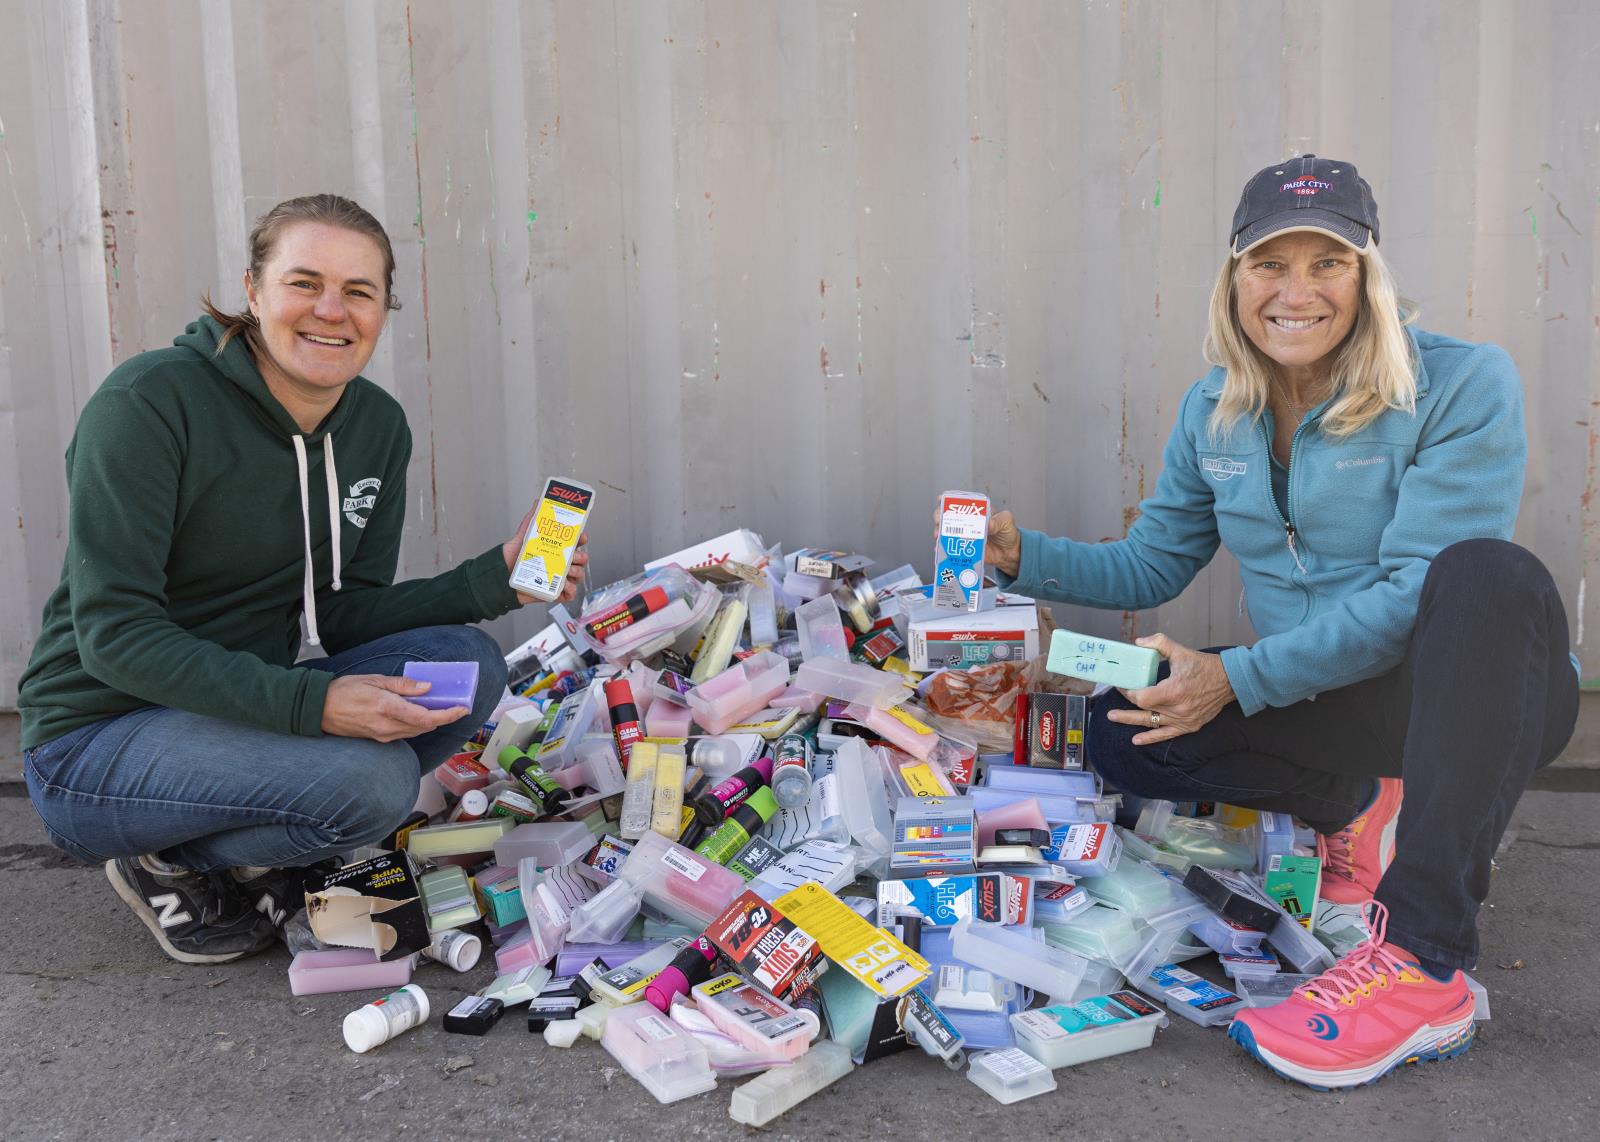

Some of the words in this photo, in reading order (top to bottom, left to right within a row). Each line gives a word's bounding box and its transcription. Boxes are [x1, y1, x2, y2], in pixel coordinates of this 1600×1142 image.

[1283, 180, 1305, 190] PARK
[1308, 180, 1330, 189] CITY
[345, 498, 368, 509] PARK
[948, 503, 984, 516] swix
[947, 538, 976, 557] LF6
[951, 632, 977, 640] swix
[1078, 640, 1094, 652] CH
[520, 774, 540, 794] VAUHTI
[729, 788, 748, 806] VAUHTI
[1083, 827, 1100, 858] swix
[370, 868, 403, 880] WIPE
[373, 876, 406, 888] FLUOR
[936, 882, 956, 918] HF6
[983, 878, 995, 920] swix
[149, 892, 193, 928] N
[761, 927, 786, 954] CERA
[752, 948, 766, 963] F
[760, 942, 800, 981] SWIX
